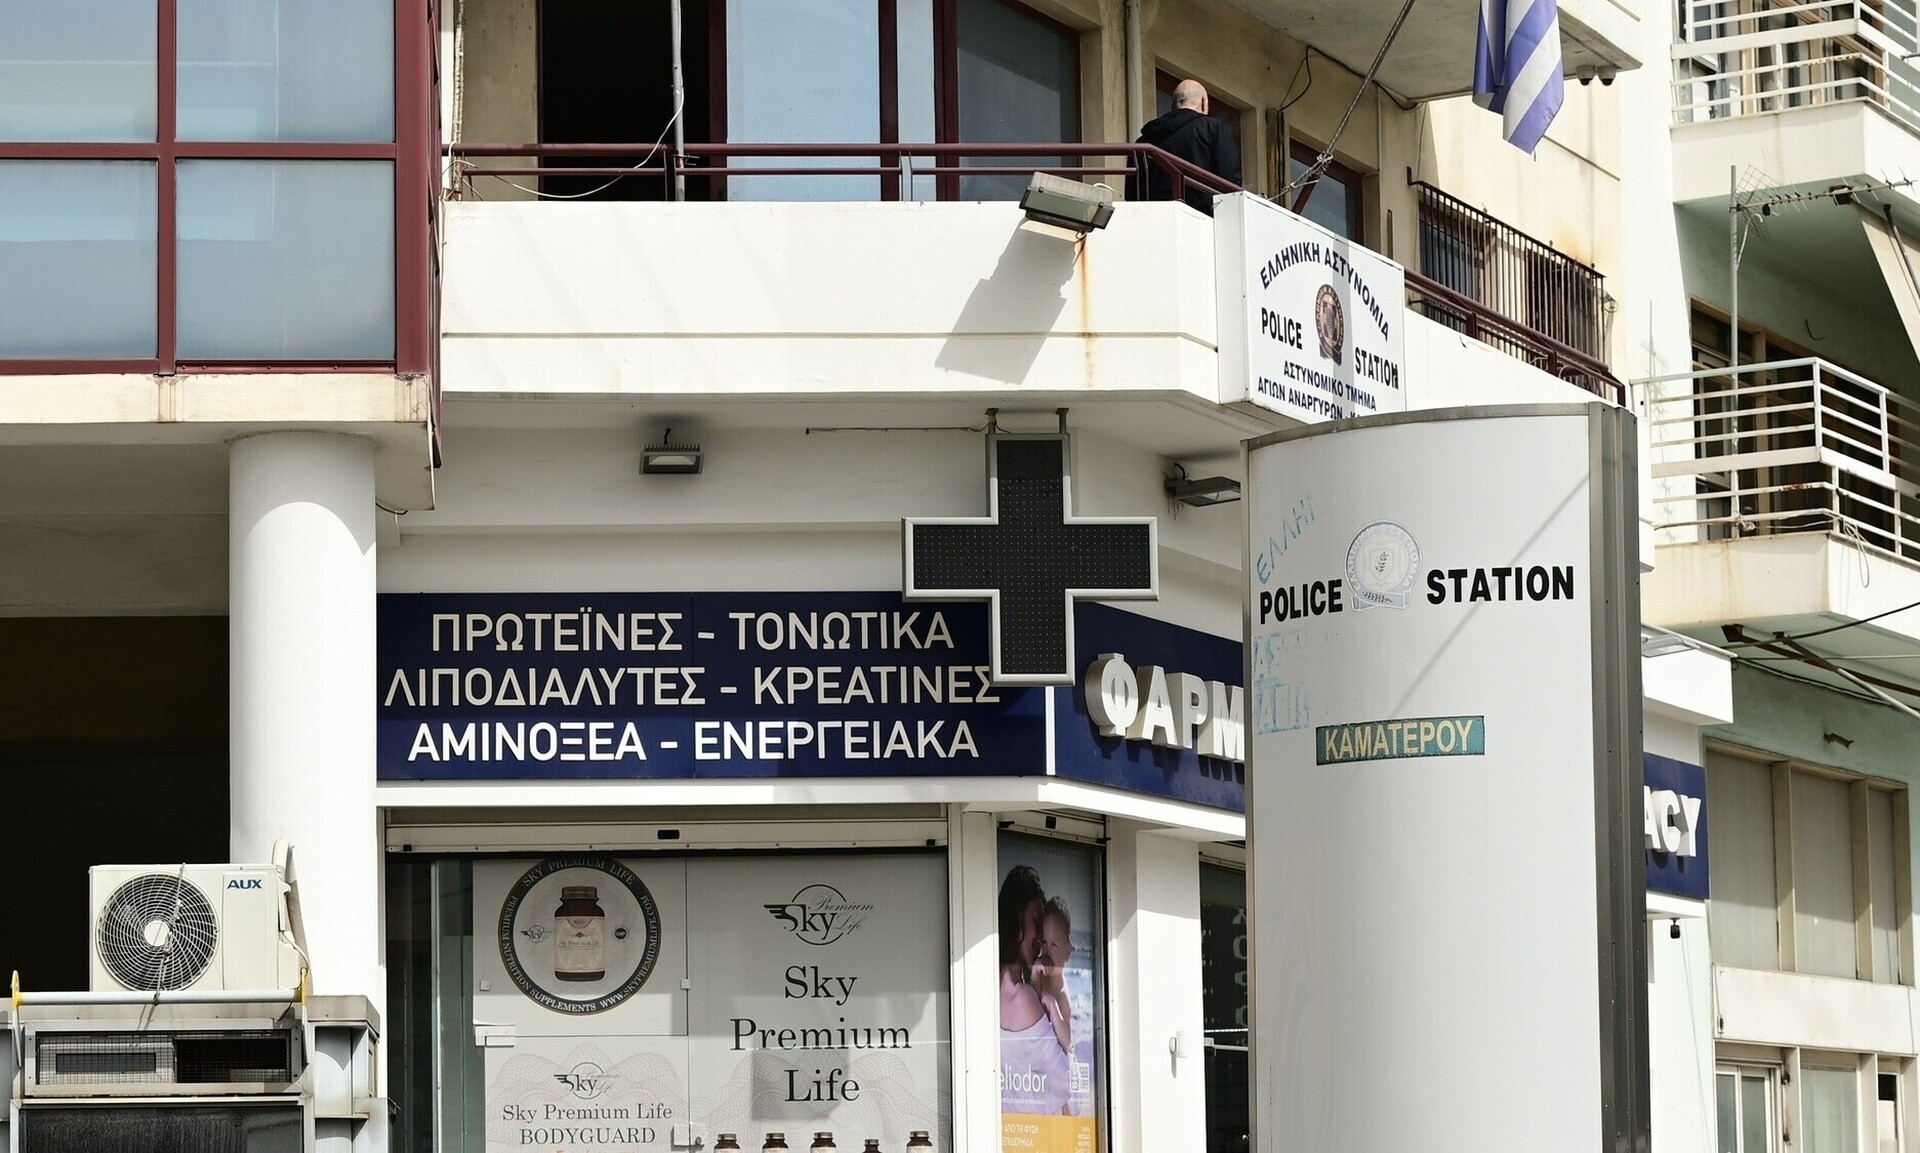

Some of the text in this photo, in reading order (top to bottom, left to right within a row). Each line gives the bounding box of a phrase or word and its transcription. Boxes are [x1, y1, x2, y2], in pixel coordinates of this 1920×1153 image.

[1259, 242, 1320, 290] ΕΛΛΗΝΙΚΗ
[1324, 247, 1389, 342] ΑΣΤΥΝΟΜΙΑ
[1261, 307, 1303, 350] POLICE
[1355, 347, 1399, 390] STATION
[1258, 376, 1343, 420] ΑΓΙΩΝ ΑΝΑΡΓΥΡΩΝ
[1284, 360, 1377, 412] ΑΣΤΥΝΟΜΙΚΟ ΤΜΗΜΑ
[1260, 565, 1574, 625] POLICE STATION
[432, 606, 683, 651] ΠΡΩΤΕΪΝΕΣ
[728, 611, 955, 651] ΤΟΝΩΤΙΚΑ
[384, 667, 706, 707] ΛΙΠΟΔΙΑΛΥΤΕΣ
[754, 665, 1000, 705] ΚΡΕΑΤΙΝΕΣ
[1086, 653, 1246, 762] ΦΑΡΜ
[407, 721, 647, 762] ΑΜΙΝΟΞΕΑ
[694, 719, 980, 760] ΕΝΕΡΓΕΙΑΚΑ
[1325, 719, 1474, 761] ΚΑΜΑΤΕΡΟΥ
[1643, 785, 1702, 858] ACY
[227, 879, 263, 890] AUX
[522, 867, 544, 887] SKY
[609, 864, 637, 885] LIFE
[502, 895, 519, 940] PREMIUM
[763, 903, 838, 941] Sky
[811, 894, 875, 911] Premium
[834, 912, 867, 935] Life
[503, 940, 532, 991] NUTRITION
[784, 965, 858, 1006] Sky
[530, 988, 597, 1012] SUPPLEMENTS
[730, 1017, 913, 1051] Premium
[553, 1073, 599, 1097] Sky
[784, 1068, 860, 1102] Life
[502, 1102, 673, 1124] Sky Premium Life
[519, 1127, 656, 1145] BODYGUARD
